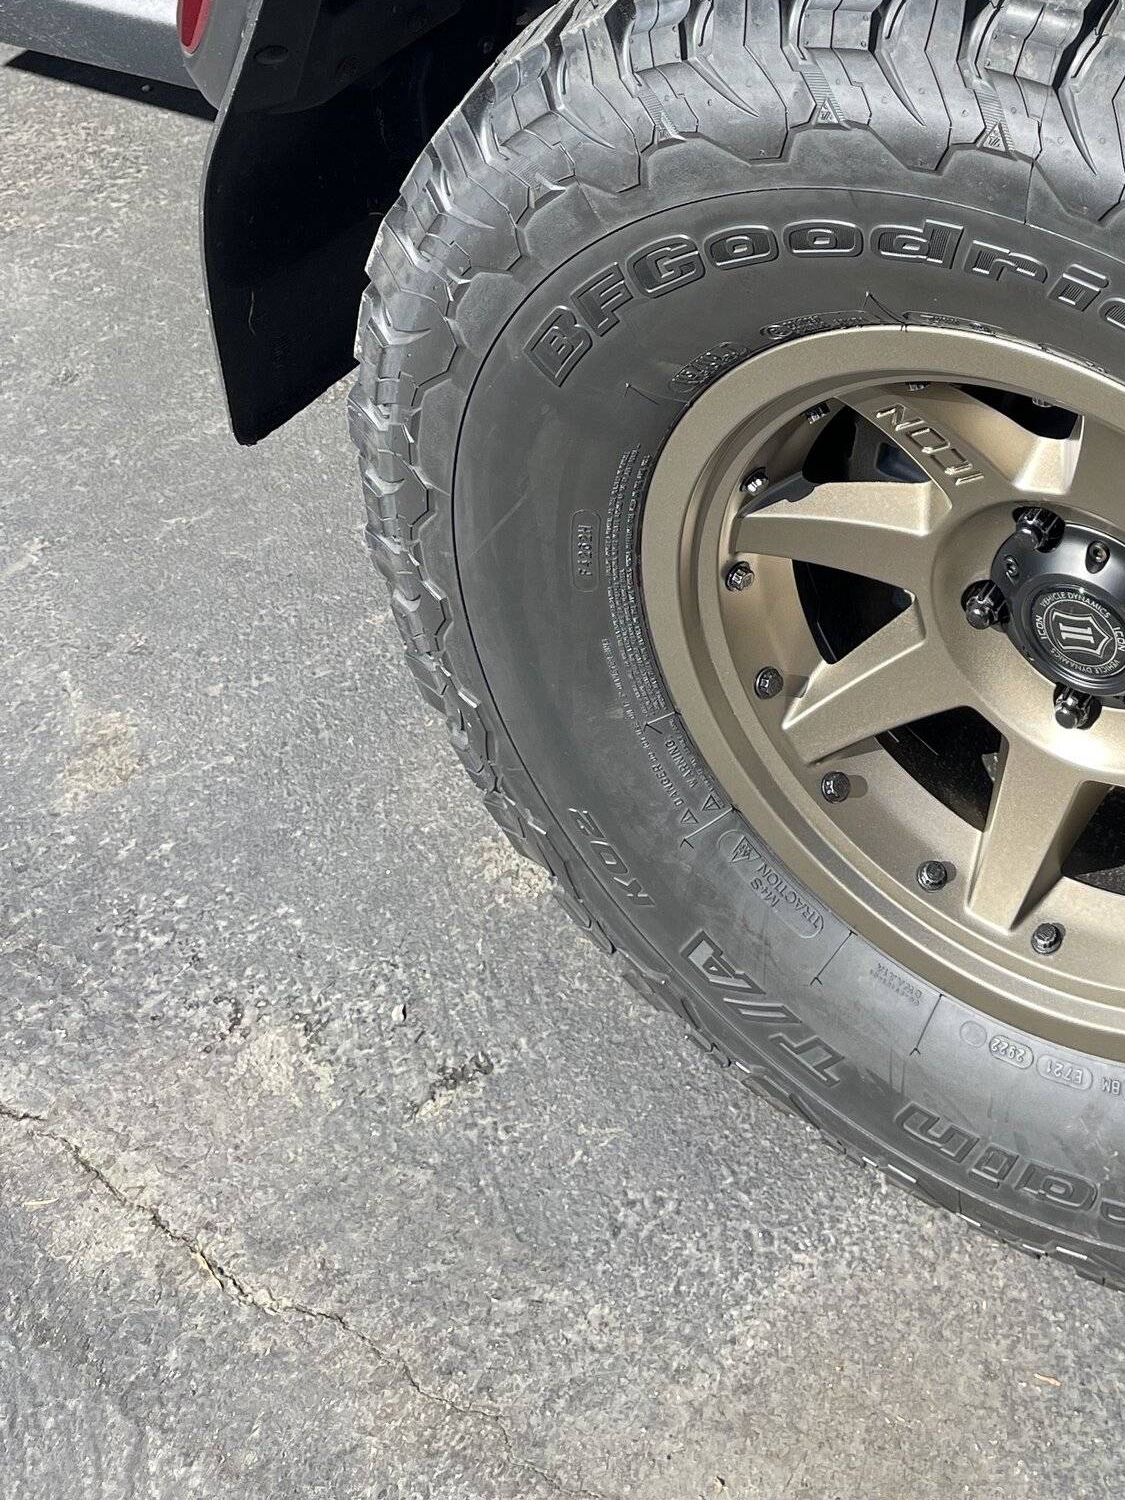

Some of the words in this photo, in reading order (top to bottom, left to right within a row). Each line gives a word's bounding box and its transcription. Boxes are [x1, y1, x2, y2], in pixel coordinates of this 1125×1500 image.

[875, 402, 985, 486] ICON
[1039, 591, 1066, 608] VEHICLE
[1067, 591, 1111, 619] DYNAMICS
[1035, 614, 1048, 639] ICON
[1113, 626, 1125, 651] ICON
[1050, 647, 1092, 673] DYNAMICS
[1094, 658, 1120, 674] VEHICLE
[662, 739, 699, 789] WARNING
[651, 763, 685, 808] DANGER
[569, 807, 656, 907] KO2
[757, 863, 822, 930] TRACTION
[680, 930, 845, 1088] T/A
[991, 1036, 1028, 1062] 2922
[1044, 1059, 1085, 1085] E721
